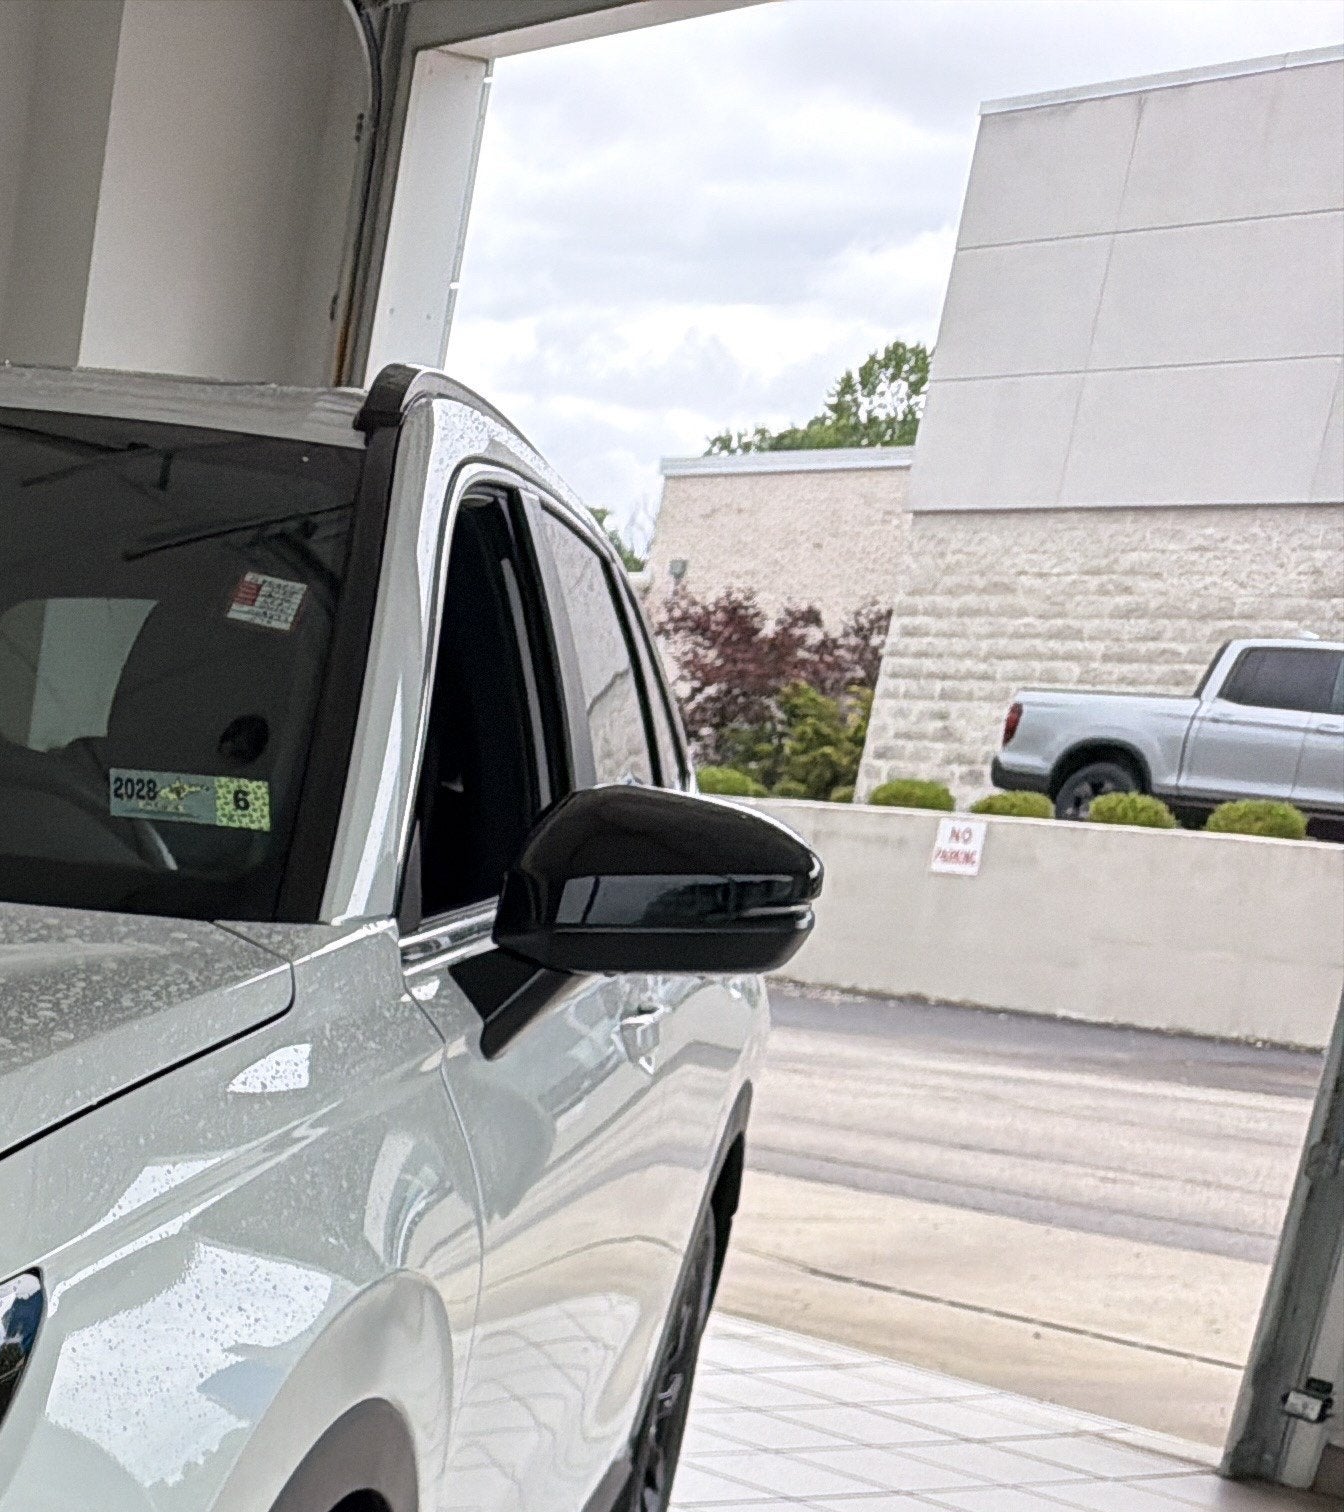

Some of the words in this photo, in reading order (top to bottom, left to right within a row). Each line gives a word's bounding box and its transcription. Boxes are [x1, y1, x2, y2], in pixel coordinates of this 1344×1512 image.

[113, 776, 158, 801] 2028
[233, 788, 251, 811] 6
[949, 826, 973, 845] NO
